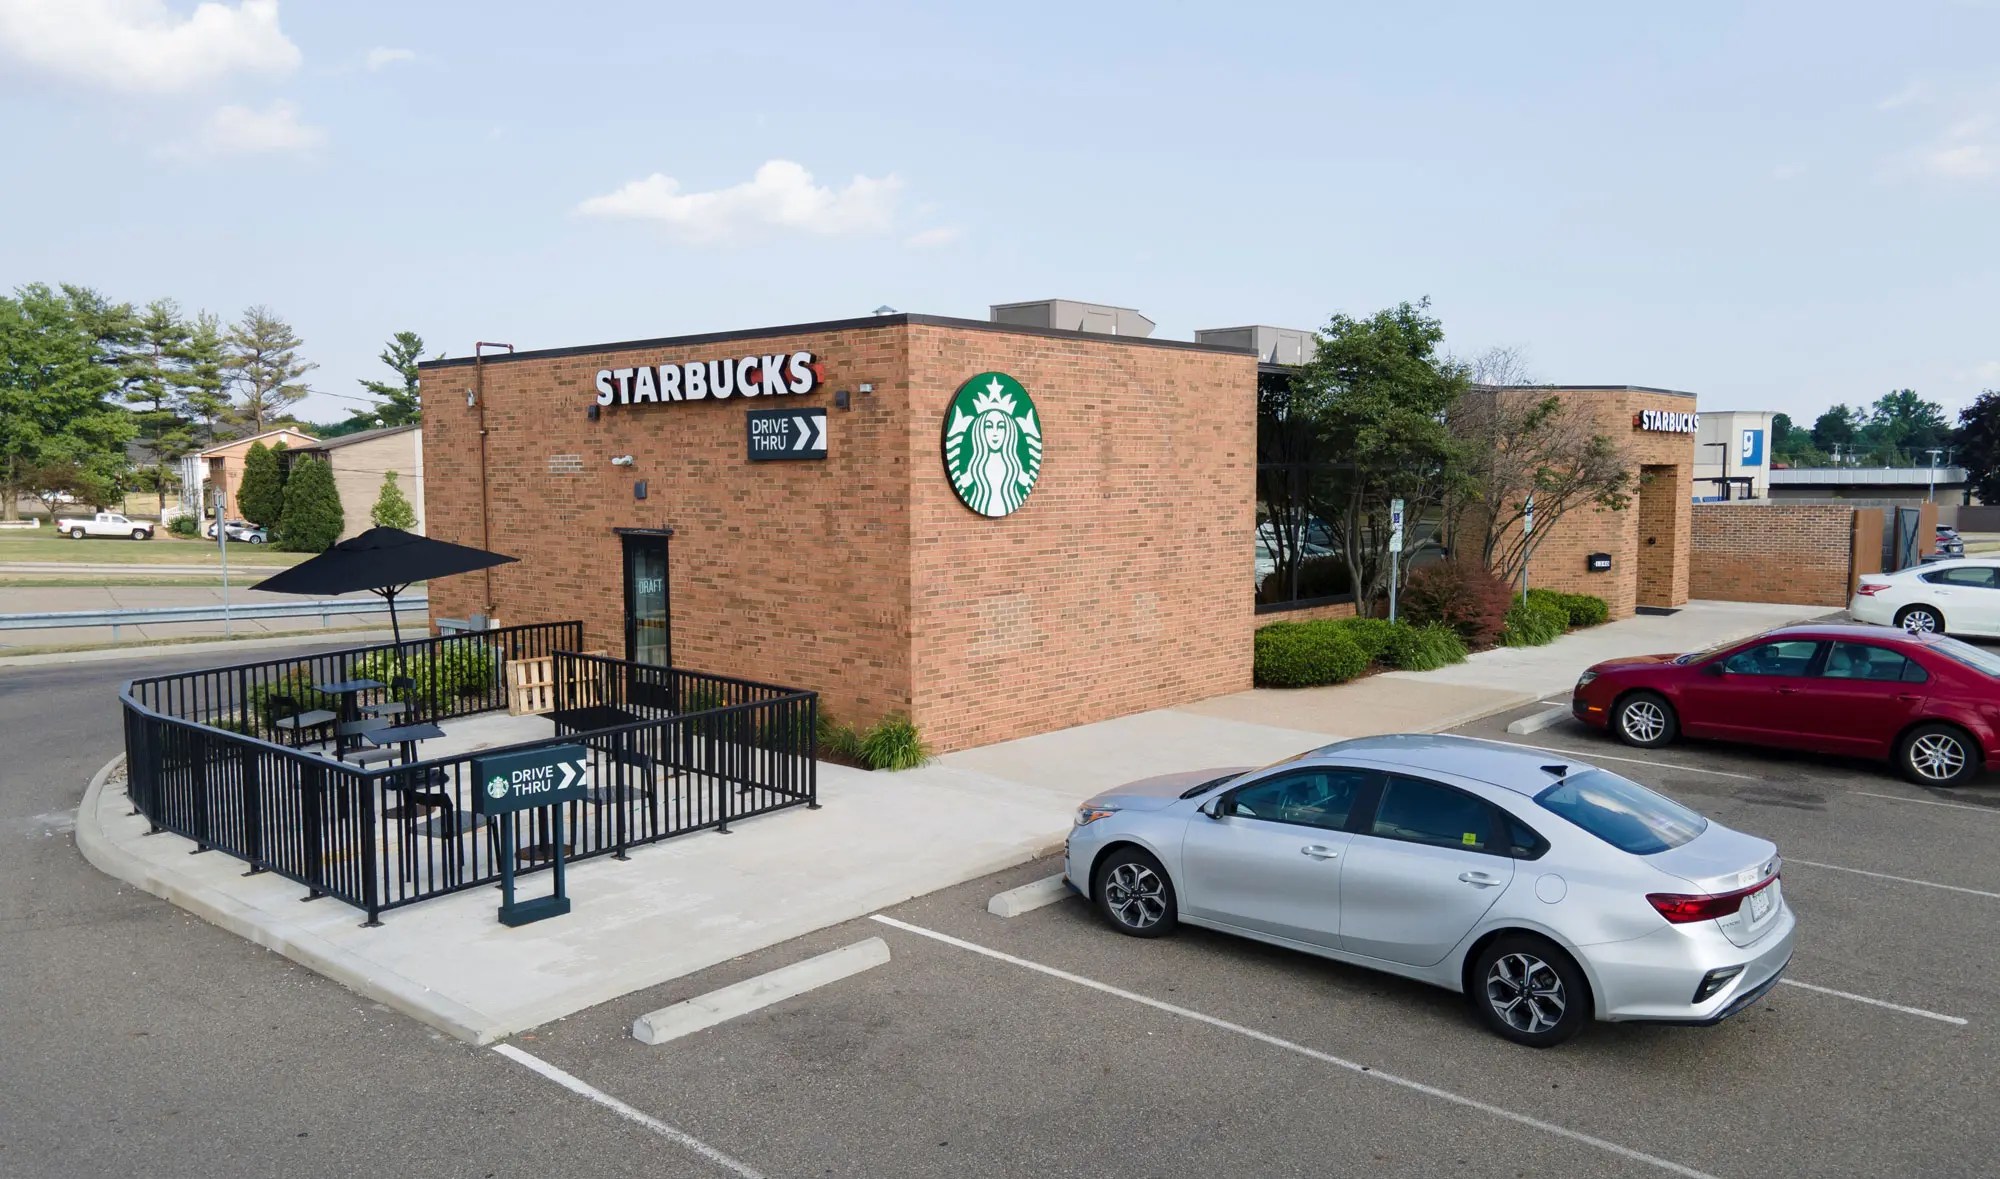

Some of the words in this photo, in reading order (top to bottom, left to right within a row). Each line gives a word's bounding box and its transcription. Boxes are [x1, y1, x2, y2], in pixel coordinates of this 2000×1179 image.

[596, 352, 813, 406] STARBUCKS
[752, 418, 789, 434] DRIVE
[1642, 409, 1700, 433] STARBUCKS
[752, 435, 787, 451] THRU
[638, 578, 662, 594] DRAFT
[512, 765, 554, 784] DRIVE
[512, 779, 551, 797] THRU
